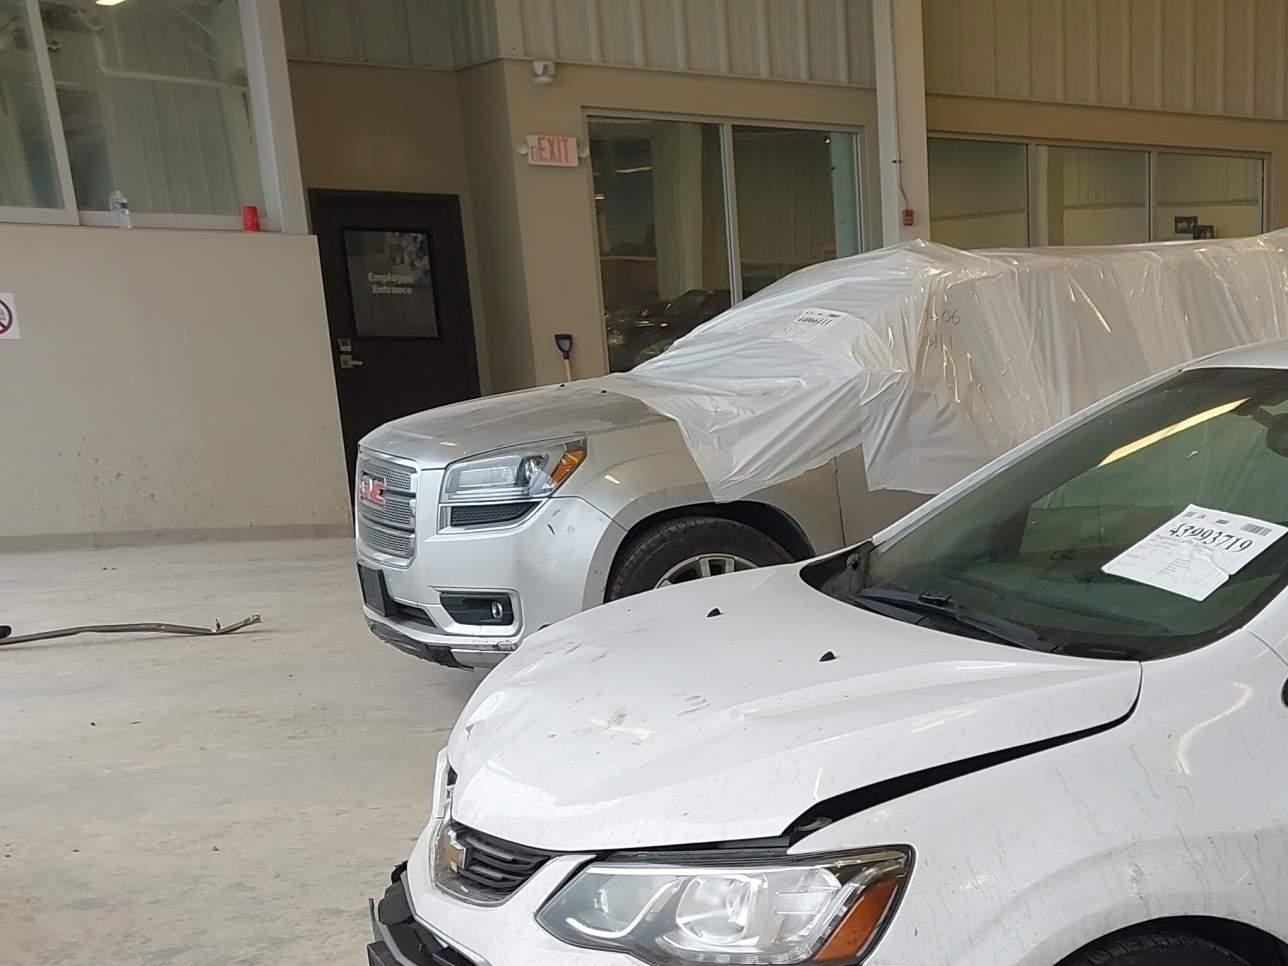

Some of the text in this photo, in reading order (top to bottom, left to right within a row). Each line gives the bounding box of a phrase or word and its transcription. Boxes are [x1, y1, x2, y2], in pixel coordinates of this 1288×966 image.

[538, 136, 569, 162] EXIT
[372, 285, 413, 294] Entrance
[1168, 522, 1254, 553] 43993719
